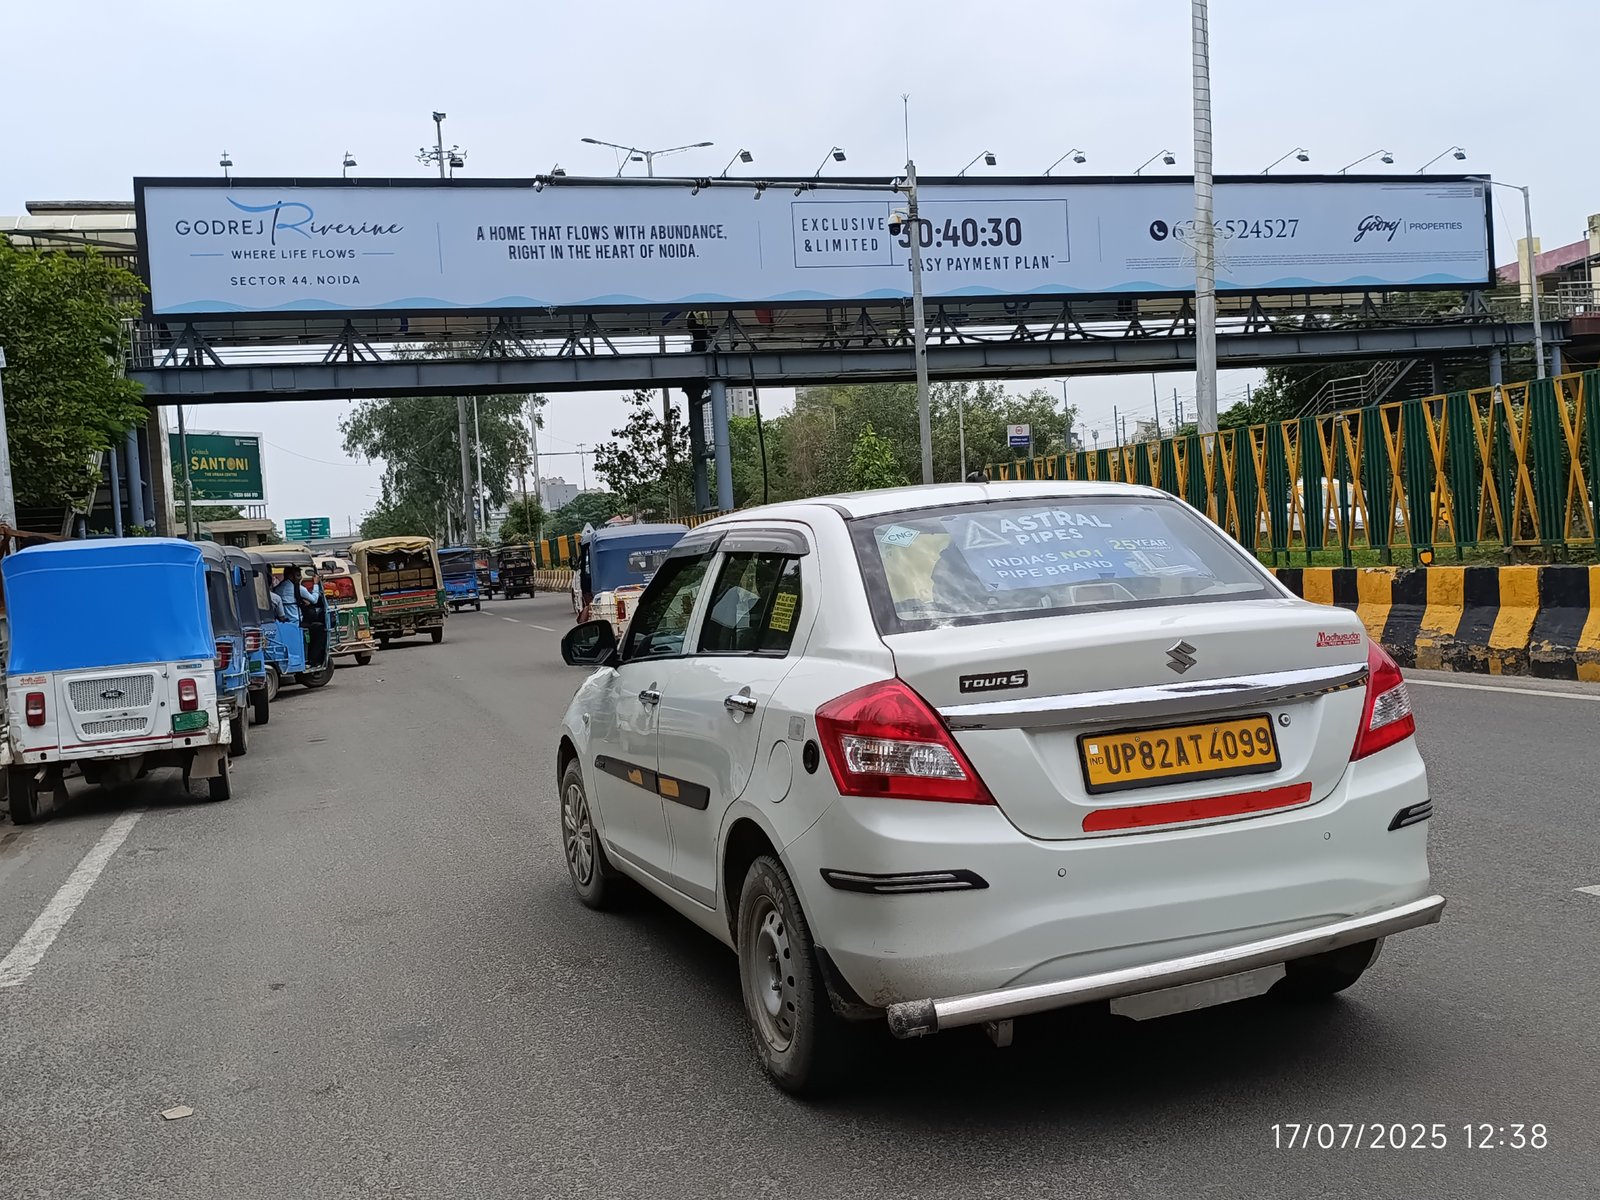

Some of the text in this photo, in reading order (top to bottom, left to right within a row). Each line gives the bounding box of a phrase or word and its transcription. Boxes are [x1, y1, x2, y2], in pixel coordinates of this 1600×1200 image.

[175, 196, 404, 245] GODREJ Riverine
[801, 217, 885, 232] EXCLUSIVE
[1354, 214, 1463, 242] Godrej PROPERTIES
[476, 225, 727, 241] A HOME THAT FLOWS WITH ABUNDANCE,
[898, 218, 1022, 248] 30:40:30
[508, 243, 700, 260] RIGHT IN THE HEART OF NOIDA.
[804, 238, 879, 252] &LIMITED
[231, 249, 356, 259] WHERE LIFE FLOWS
[946, 256, 1010, 271] PAYMENT
[230, 276, 286, 286] SECTOR
[316, 275, 360, 285] NOIDA
[191, 456, 249, 470] SANTONI
[1000, 511, 1113, 534] ASTRAL
[888, 531, 913, 541] CNG
[1015, 528, 1084, 545] PIPES
[987, 552, 1059, 568] INDIA'S
[996, 560, 1114, 579] PIPE BRAND
[1317, 631, 1360, 643] Madhusudan
[963, 673, 1024, 688] TOUR S
[1089, 756, 1104, 766] IND
